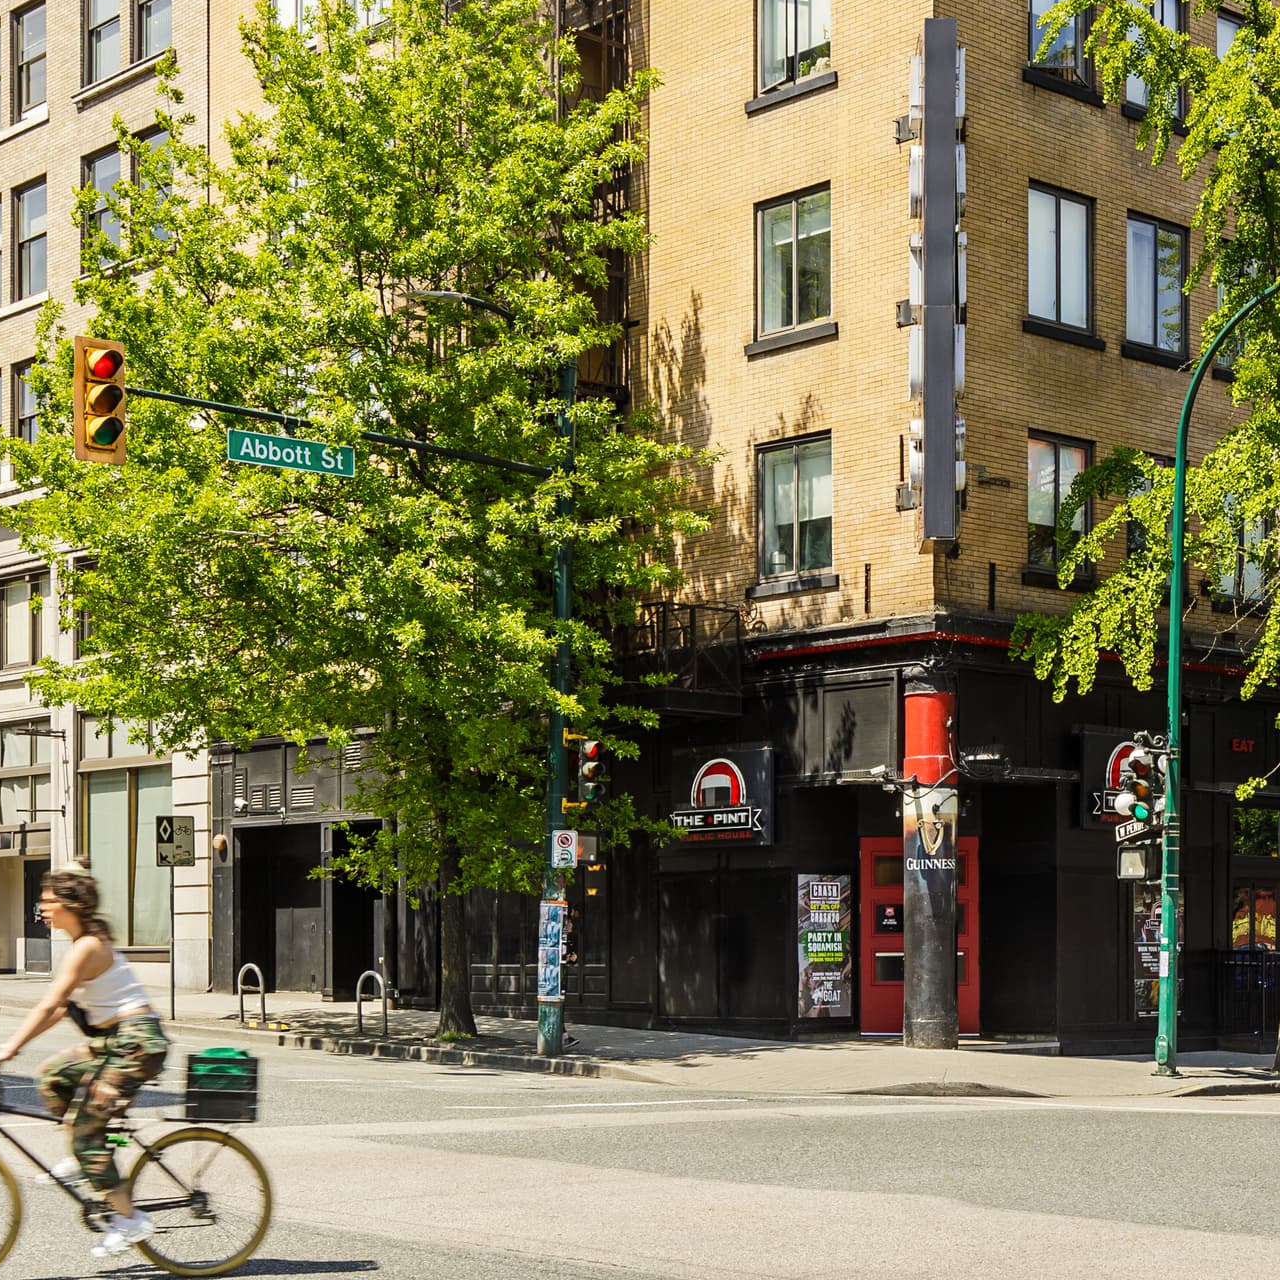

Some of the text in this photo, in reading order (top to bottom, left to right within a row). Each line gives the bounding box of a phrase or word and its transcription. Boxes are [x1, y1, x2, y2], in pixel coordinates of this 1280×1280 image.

[240, 437, 344, 470] Abbott St
[1232, 738, 1255, 752] EAT
[675, 812, 748, 826] THE PINT
[906, 857, 956, 870] GUINNESS
[813, 885, 837, 897] CRASH
[810, 912, 840, 923] CRASH20
[807, 932, 842, 942] PARTY IN
[807, 943, 843, 952] SQUAMISH
[823, 981, 833, 990] THE
[823, 990, 841, 1002] GOAT
